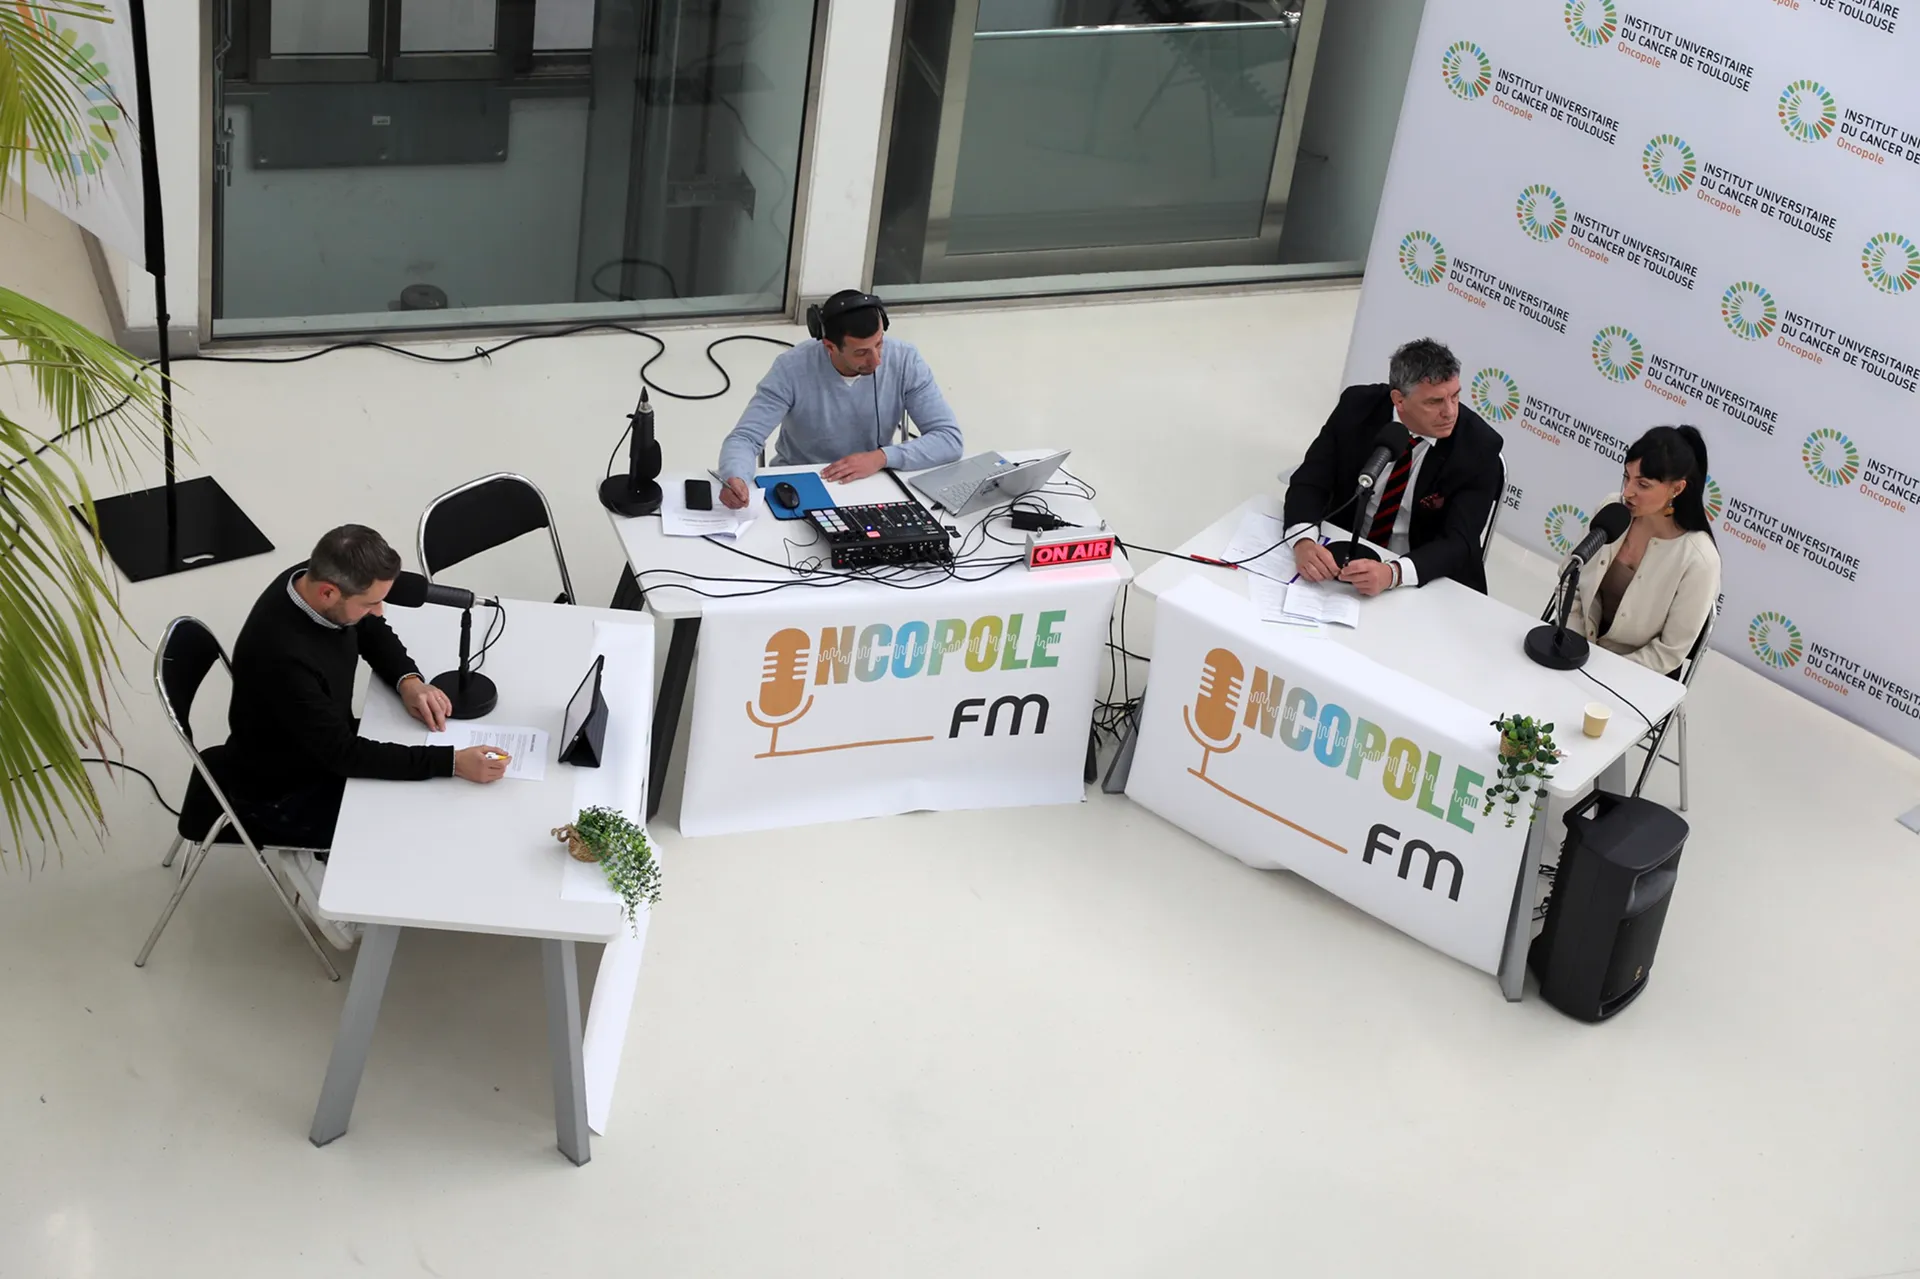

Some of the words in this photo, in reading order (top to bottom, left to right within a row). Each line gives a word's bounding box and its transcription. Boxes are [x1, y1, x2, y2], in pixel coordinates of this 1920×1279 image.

[1624, 14, 1673, 42] INSTITUT
[1675, 36, 1754, 78] UNIVERSITAIRE
[1838, 1, 1896, 34] TOULOUSE
[1617, 42, 1661, 68] Oncopole
[1621, 27, 1636, 42] DU
[1638, 35, 1678, 60] CANCER
[1679, 53, 1695, 68] DE
[1697, 59, 1750, 92] TOULOUSE
[1492, 95, 1533, 121] Oncopole
[1495, 81, 1510, 95] DU
[1511, 89, 1548, 114] CANCER
[1550, 107, 1564, 121] DE
[1566, 113, 1616, 145] TOULOUSE
[1498, 68, 1544, 96] INSTITUT
[1545, 90, 1619, 132] UNIVERSITAIRE
[1844, 108, 1899, 138] INSTITUT
[1837, 136, 1884, 164] Oncopole
[1840, 122, 1858, 137] DU
[1860, 131, 1903, 157] CANCER
[1697, 189, 1741, 216] Oncopole
[1700, 175, 1716, 190] DU
[1718, 184, 1758, 209] CANCER
[1760, 202, 1776, 217] DE
[1778, 209, 1833, 243] TOULOUSE
[1704, 162, 1754, 191] INSTITUT
[1755, 185, 1837, 229] UNIVERSITAIRE
[1567, 237, 1609, 264] Oncopole
[1570, 224, 1586, 238] DU
[1587, 232, 1625, 257] CANCER
[1627, 251, 1641, 265] DE
[1643, 257, 1695, 290] TOULOUSE
[1574, 212, 1621, 240] INSTITUT
[1622, 234, 1698, 277] UNIVERSITAIRE
[1447, 282, 1486, 308] Oncopole
[1450, 269, 1464, 283] DU
[1466, 277, 1501, 302] CANCER
[1503, 296, 1516, 310] DE
[1518, 302, 1567, 334] TOULOUSE
[1453, 257, 1497, 285] INSTITUT
[1498, 280, 1570, 322] UNIVERSITAIRE
[1777, 336, 1823, 364] Oncopole
[1781, 323, 1797, 337] DU
[1799, 332, 1841, 358] CANCER
[1842, 351, 1858, 366] DE
[1861, 359, 1917, 393] TOULOUSE
[1784, 310, 1836, 340] INSTITUT
[1837, 334, 1920, 380] UNIVERSITAIRE
[1644, 379, 1687, 407] Oncopole
[1647, 366, 1663, 380] DU
[1664, 375, 1703, 401] CANCER
[1705, 394, 1720, 409] DE
[1722, 402, 1775, 436] TOULOUSE
[1651, 354, 1699, 383] INSTITUT
[1700, 378, 1778, 423] UNIVERSITAIRE
[1520, 419, 1561, 446] Oncopole
[1523, 407, 1538, 420] DU
[1539, 415, 1576, 440] CANCER
[1577, 434, 1592, 448] DE
[1594, 441, 1624, 464] TOULO
[1526, 395, 1571, 423] INSTITUT
[1573, 418, 1630, 452] UNIVERSITA
[1860, 484, 1906, 513] Oncopole
[1863, 471, 1880, 485] DU
[1867, 458, 1920, 489] INSTITUT
[1036, 545, 1069, 563] ON
[1071, 542, 1108, 559] AIR
[1723, 521, 1766, 550] Oncopole
[1726, 509, 1742, 523] DU
[1743, 518, 1784, 545] CANCER
[1785, 539, 1800, 554] DE
[1803, 547, 1857, 582] TOULOUSE
[1729, 497, 1779, 528] INSTITUT
[1780, 523, 1860, 570] UNIVERSITAIRE
[1804, 666, 1848, 696] Oncopole
[1807, 654, 1823, 669] DU
[1825, 663, 1866, 691] CANCER
[1868, 685, 1883, 700] DE
[1886, 693, 1920, 720] TOULO
[1810, 642, 1861, 674] INSTITUT
[1862, 669, 1920, 704] UNIVERSIT
